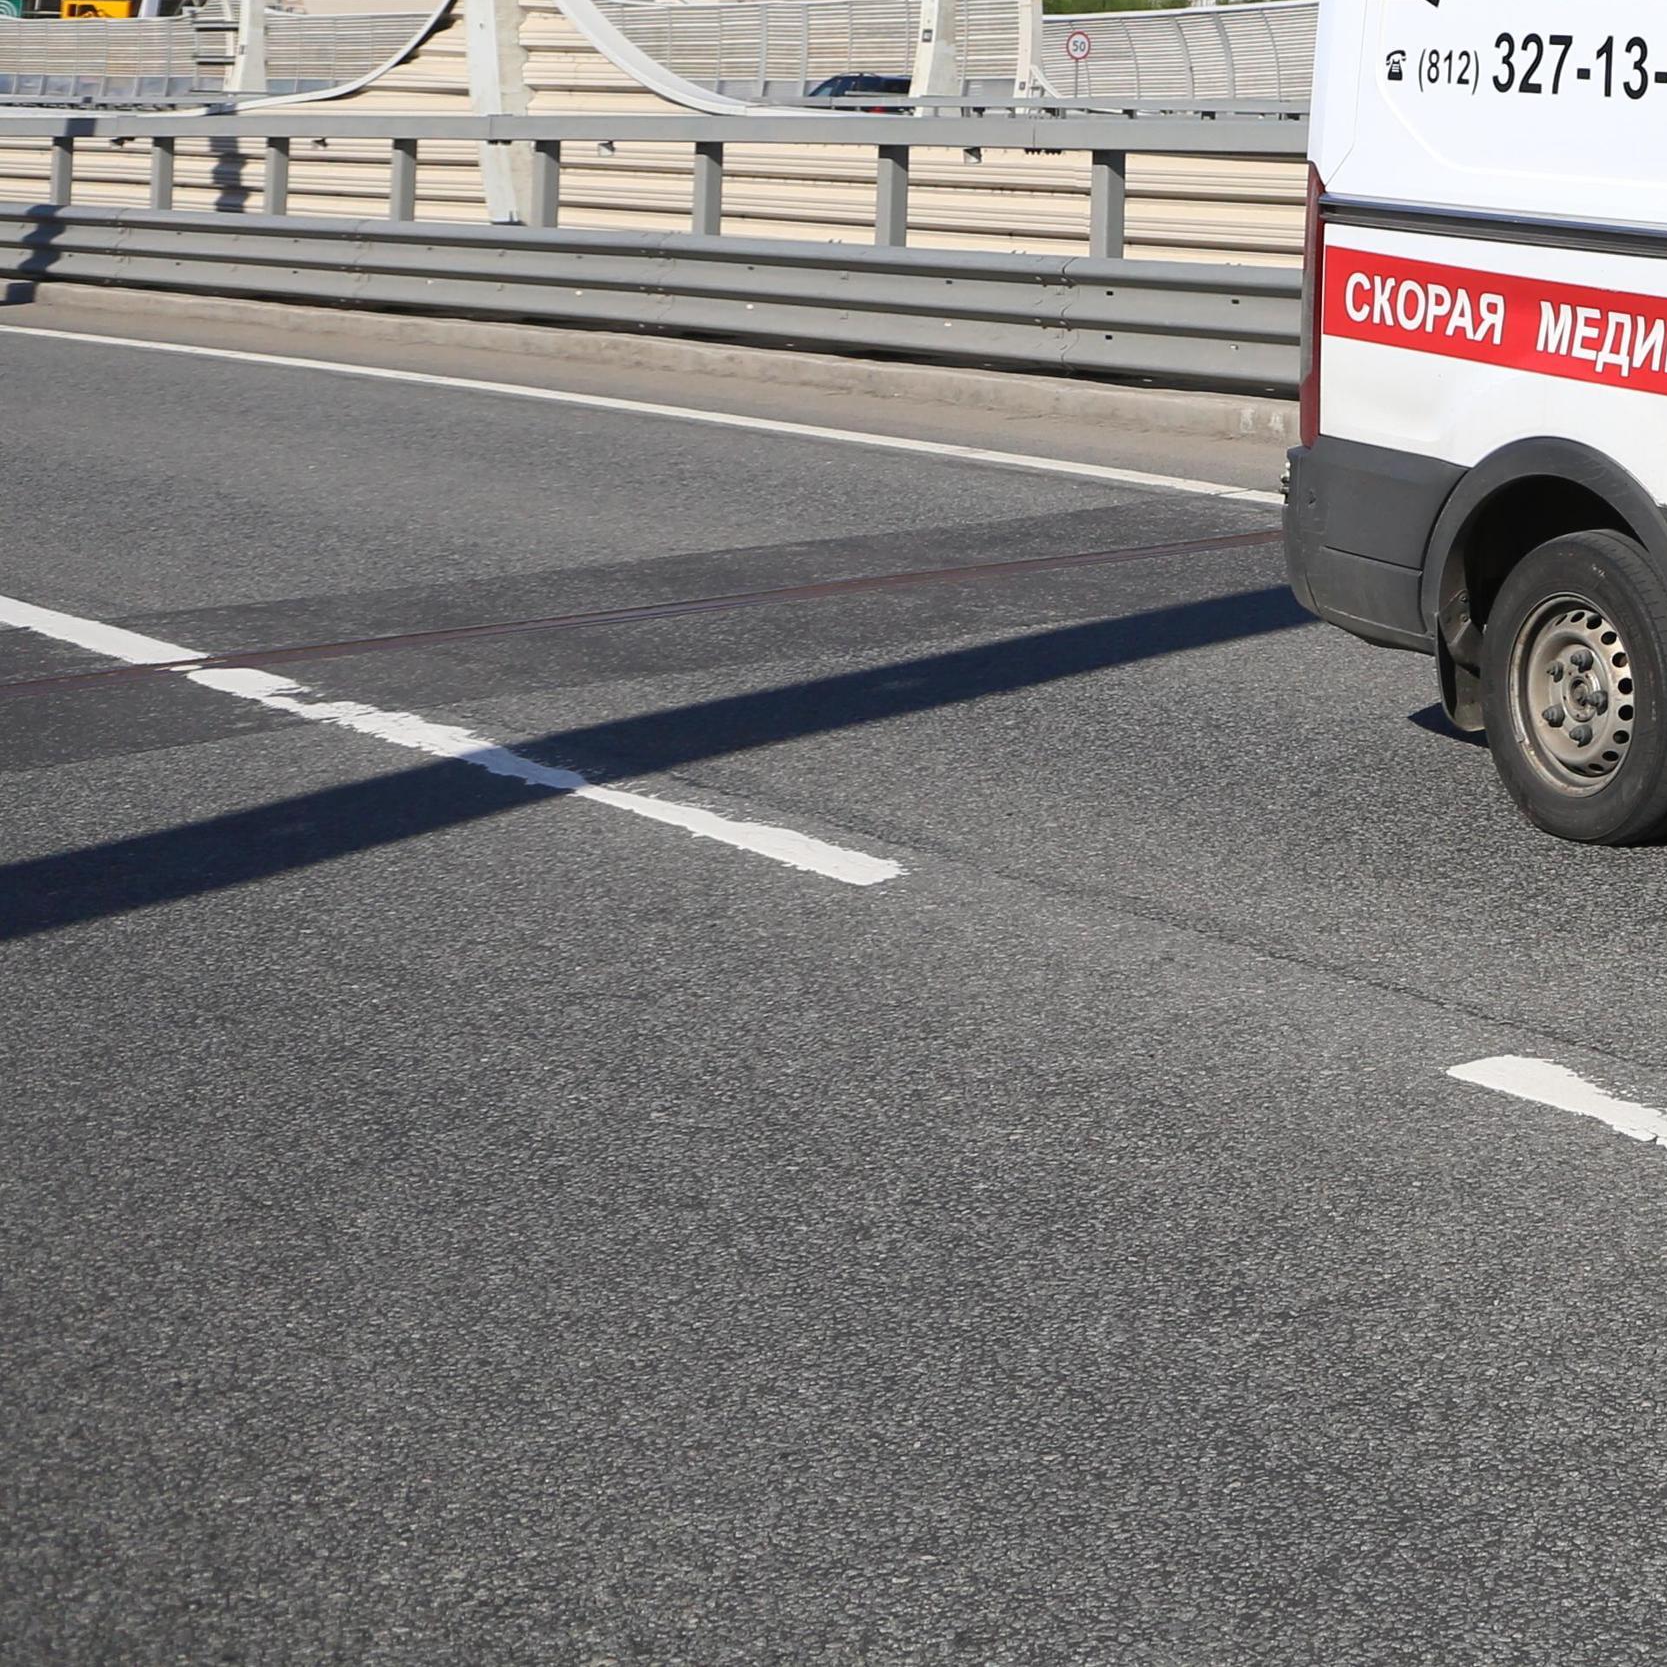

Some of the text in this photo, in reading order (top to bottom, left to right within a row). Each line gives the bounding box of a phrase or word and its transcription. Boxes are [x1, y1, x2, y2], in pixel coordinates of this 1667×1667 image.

[1072, 39, 1087, 53] 50
[1418, 47, 1480, 96] (812)
[1343, 271, 1506, 346] СКОРАЯ
